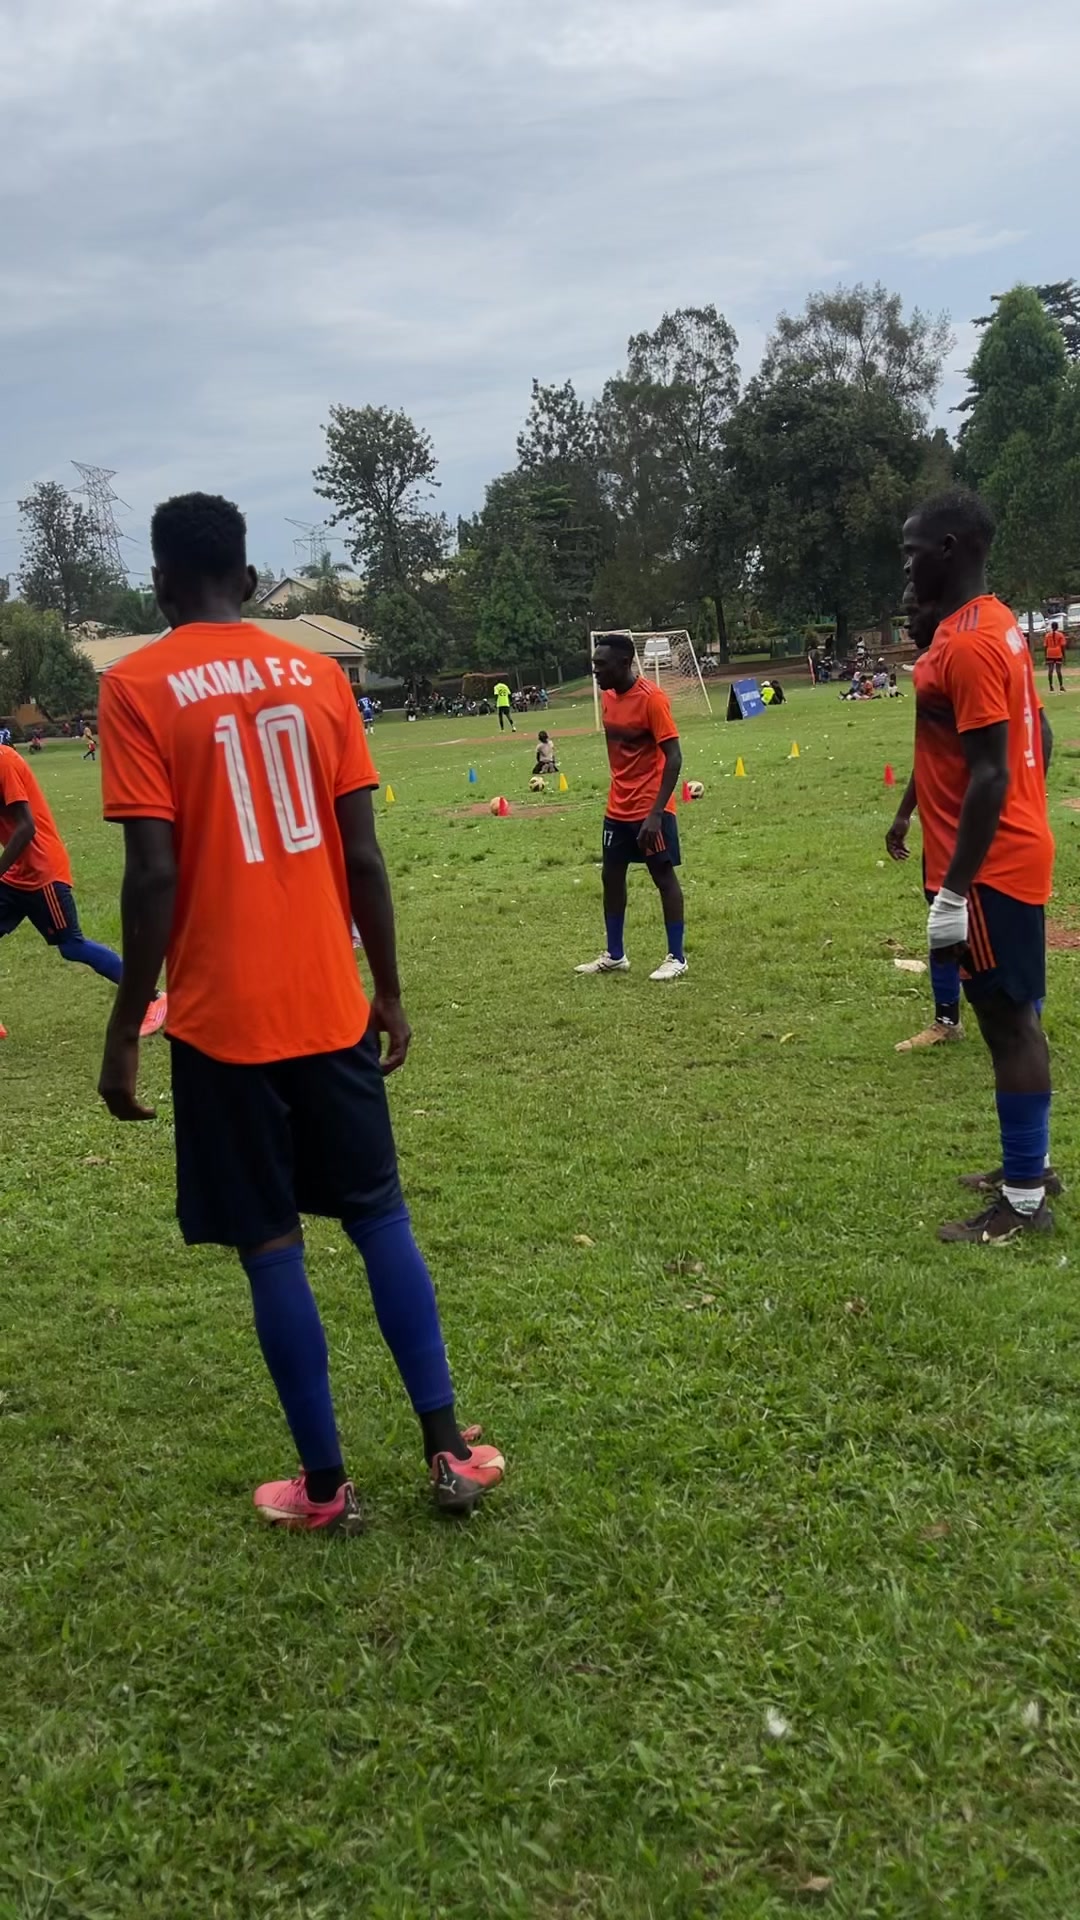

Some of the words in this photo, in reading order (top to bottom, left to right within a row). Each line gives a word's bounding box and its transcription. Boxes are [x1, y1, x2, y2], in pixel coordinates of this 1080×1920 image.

[167, 658, 266, 708] NKIMA
[265, 656, 313, 687] F.C
[214, 703, 322, 863] 10
[603, 829, 614, 846] 17
